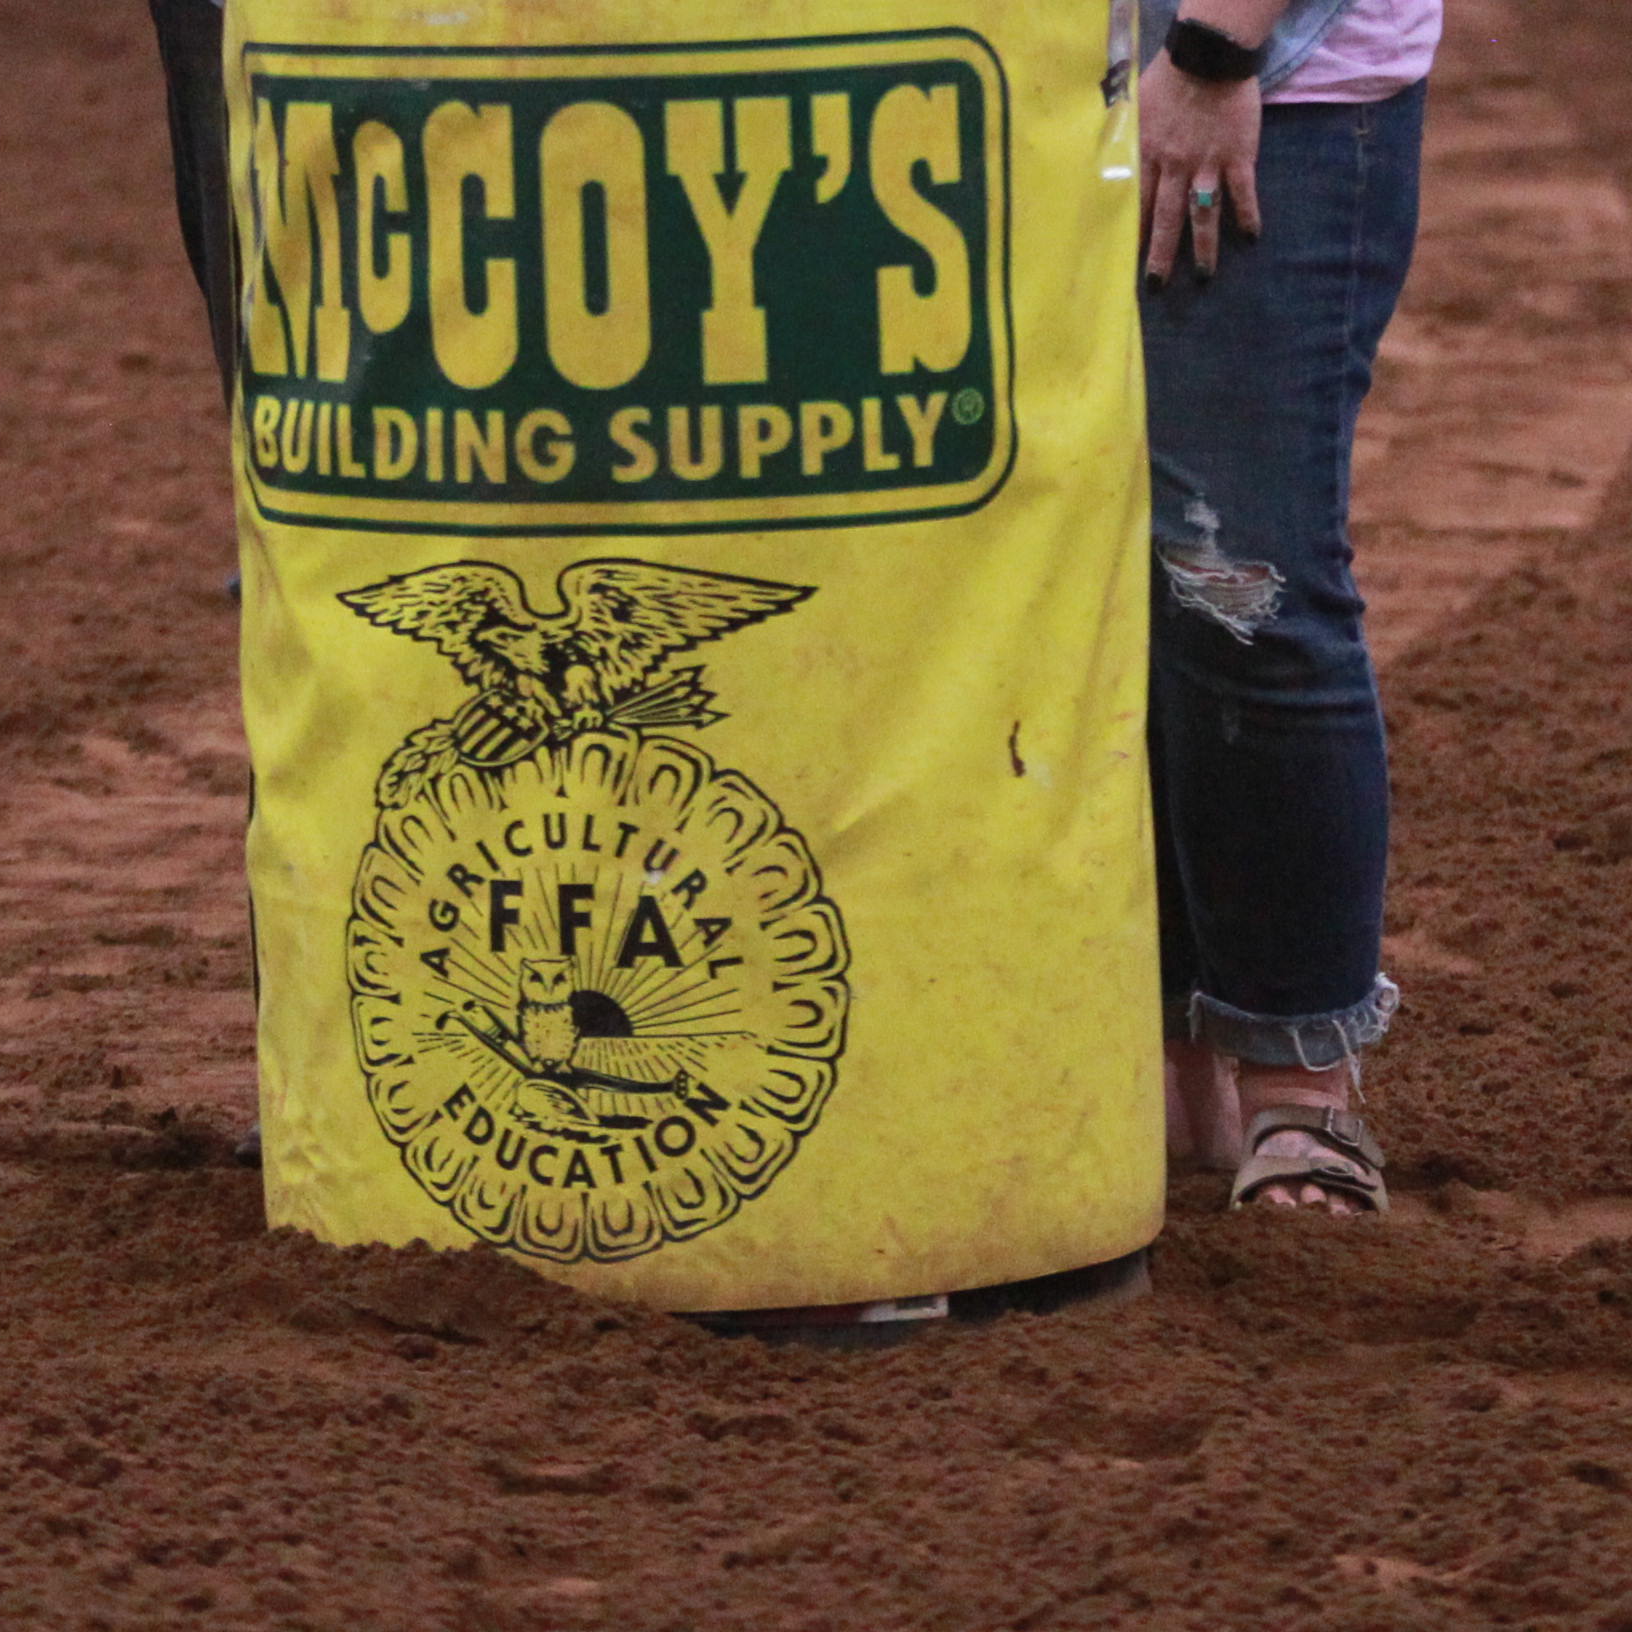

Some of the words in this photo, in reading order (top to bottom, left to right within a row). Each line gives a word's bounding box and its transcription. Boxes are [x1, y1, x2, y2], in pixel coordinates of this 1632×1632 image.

[253, 394, 576, 484] BUILDING
[420, 812, 744, 979] AGRICULTURAL
[489, 879, 684, 969] FFA
[441, 1083, 732, 1189] EDUCATION
